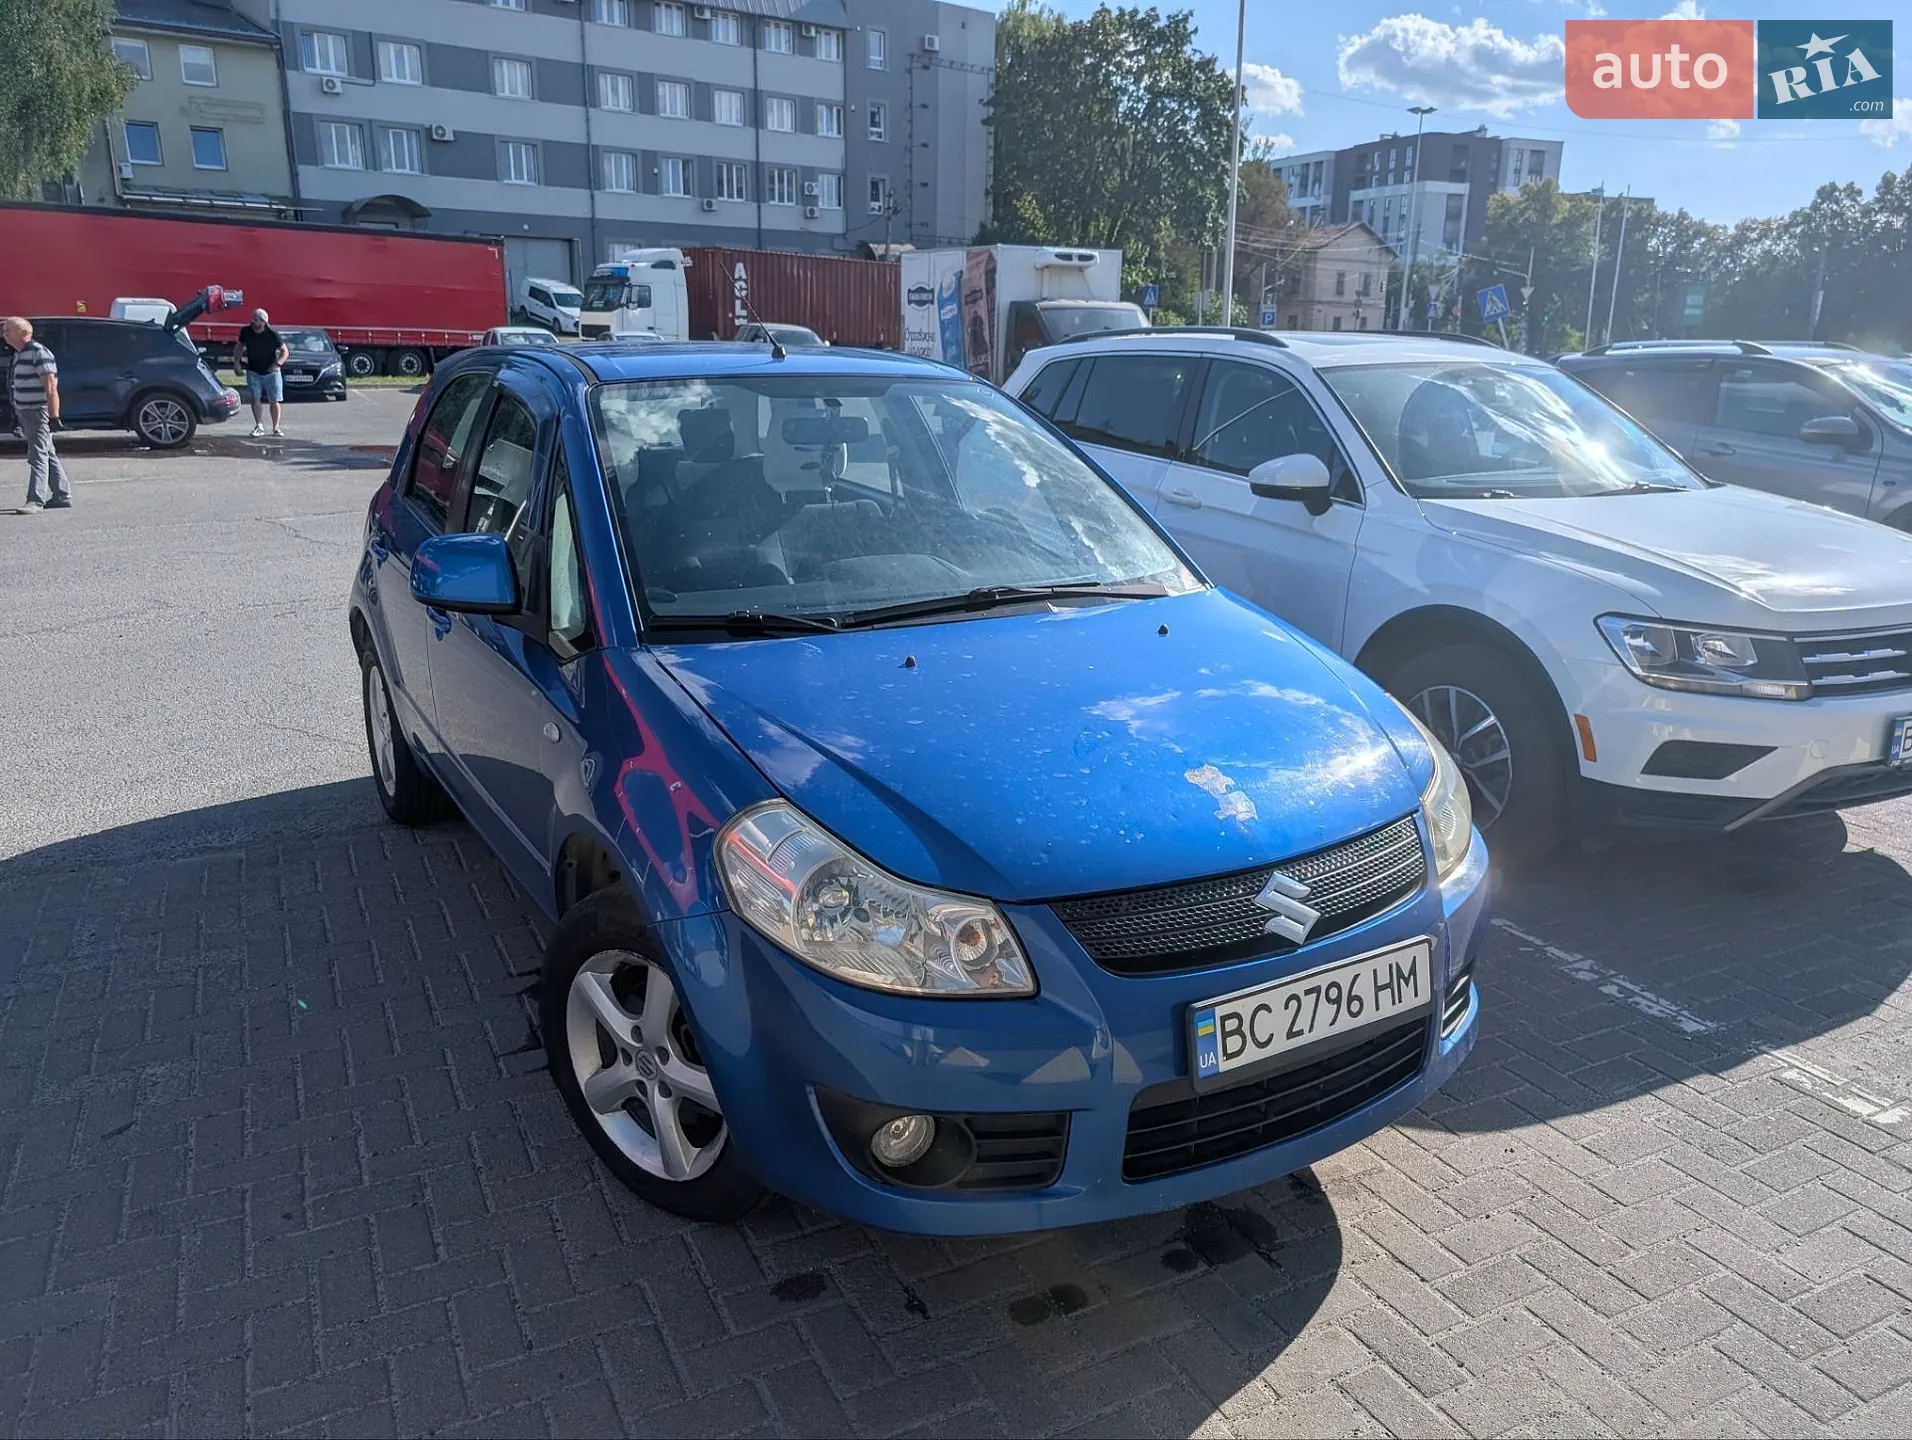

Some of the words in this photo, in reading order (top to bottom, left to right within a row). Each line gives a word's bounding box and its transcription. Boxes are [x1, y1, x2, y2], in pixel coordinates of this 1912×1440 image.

[1219, 1003, 1275, 1062] BC
[1283, 973, 1365, 1041] 2796
[1372, 955, 1419, 1012] HM
[1199, 1051, 1217, 1069] UA
